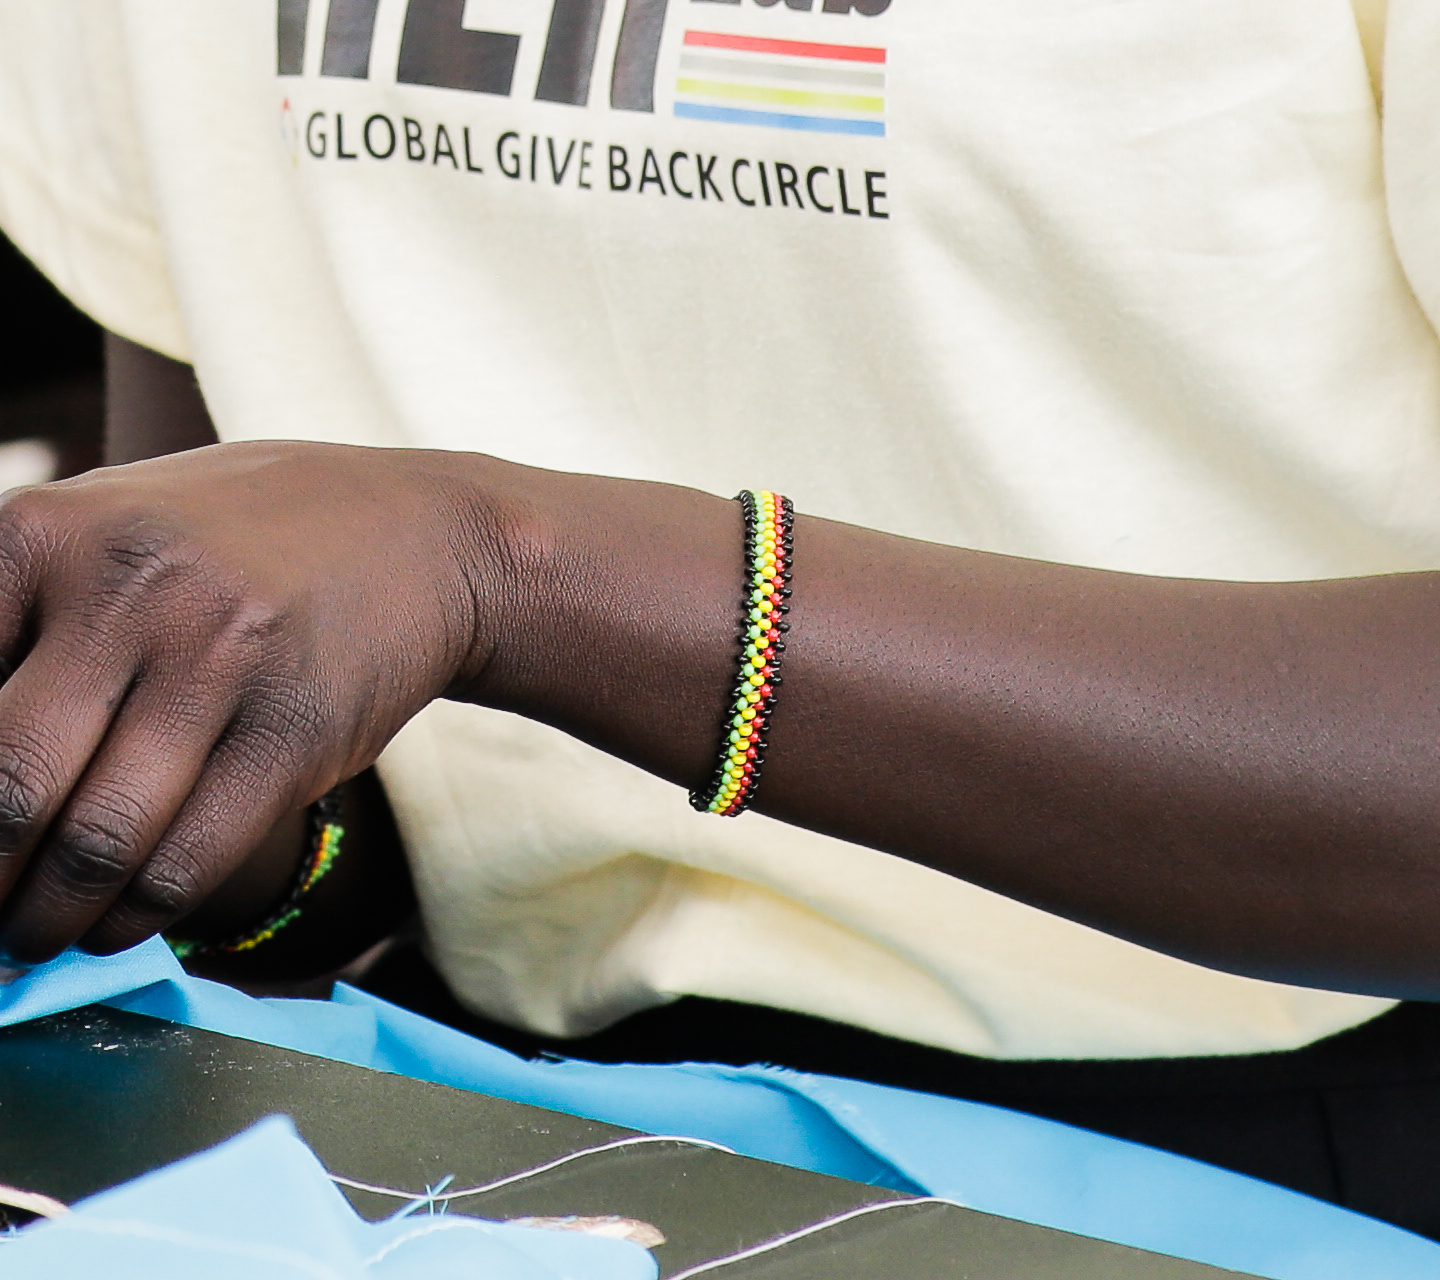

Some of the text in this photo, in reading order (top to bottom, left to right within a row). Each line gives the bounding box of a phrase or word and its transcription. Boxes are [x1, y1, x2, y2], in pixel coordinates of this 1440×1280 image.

[306, 111, 890, 219] GLOBAL GIVE BACK CIRCLE
